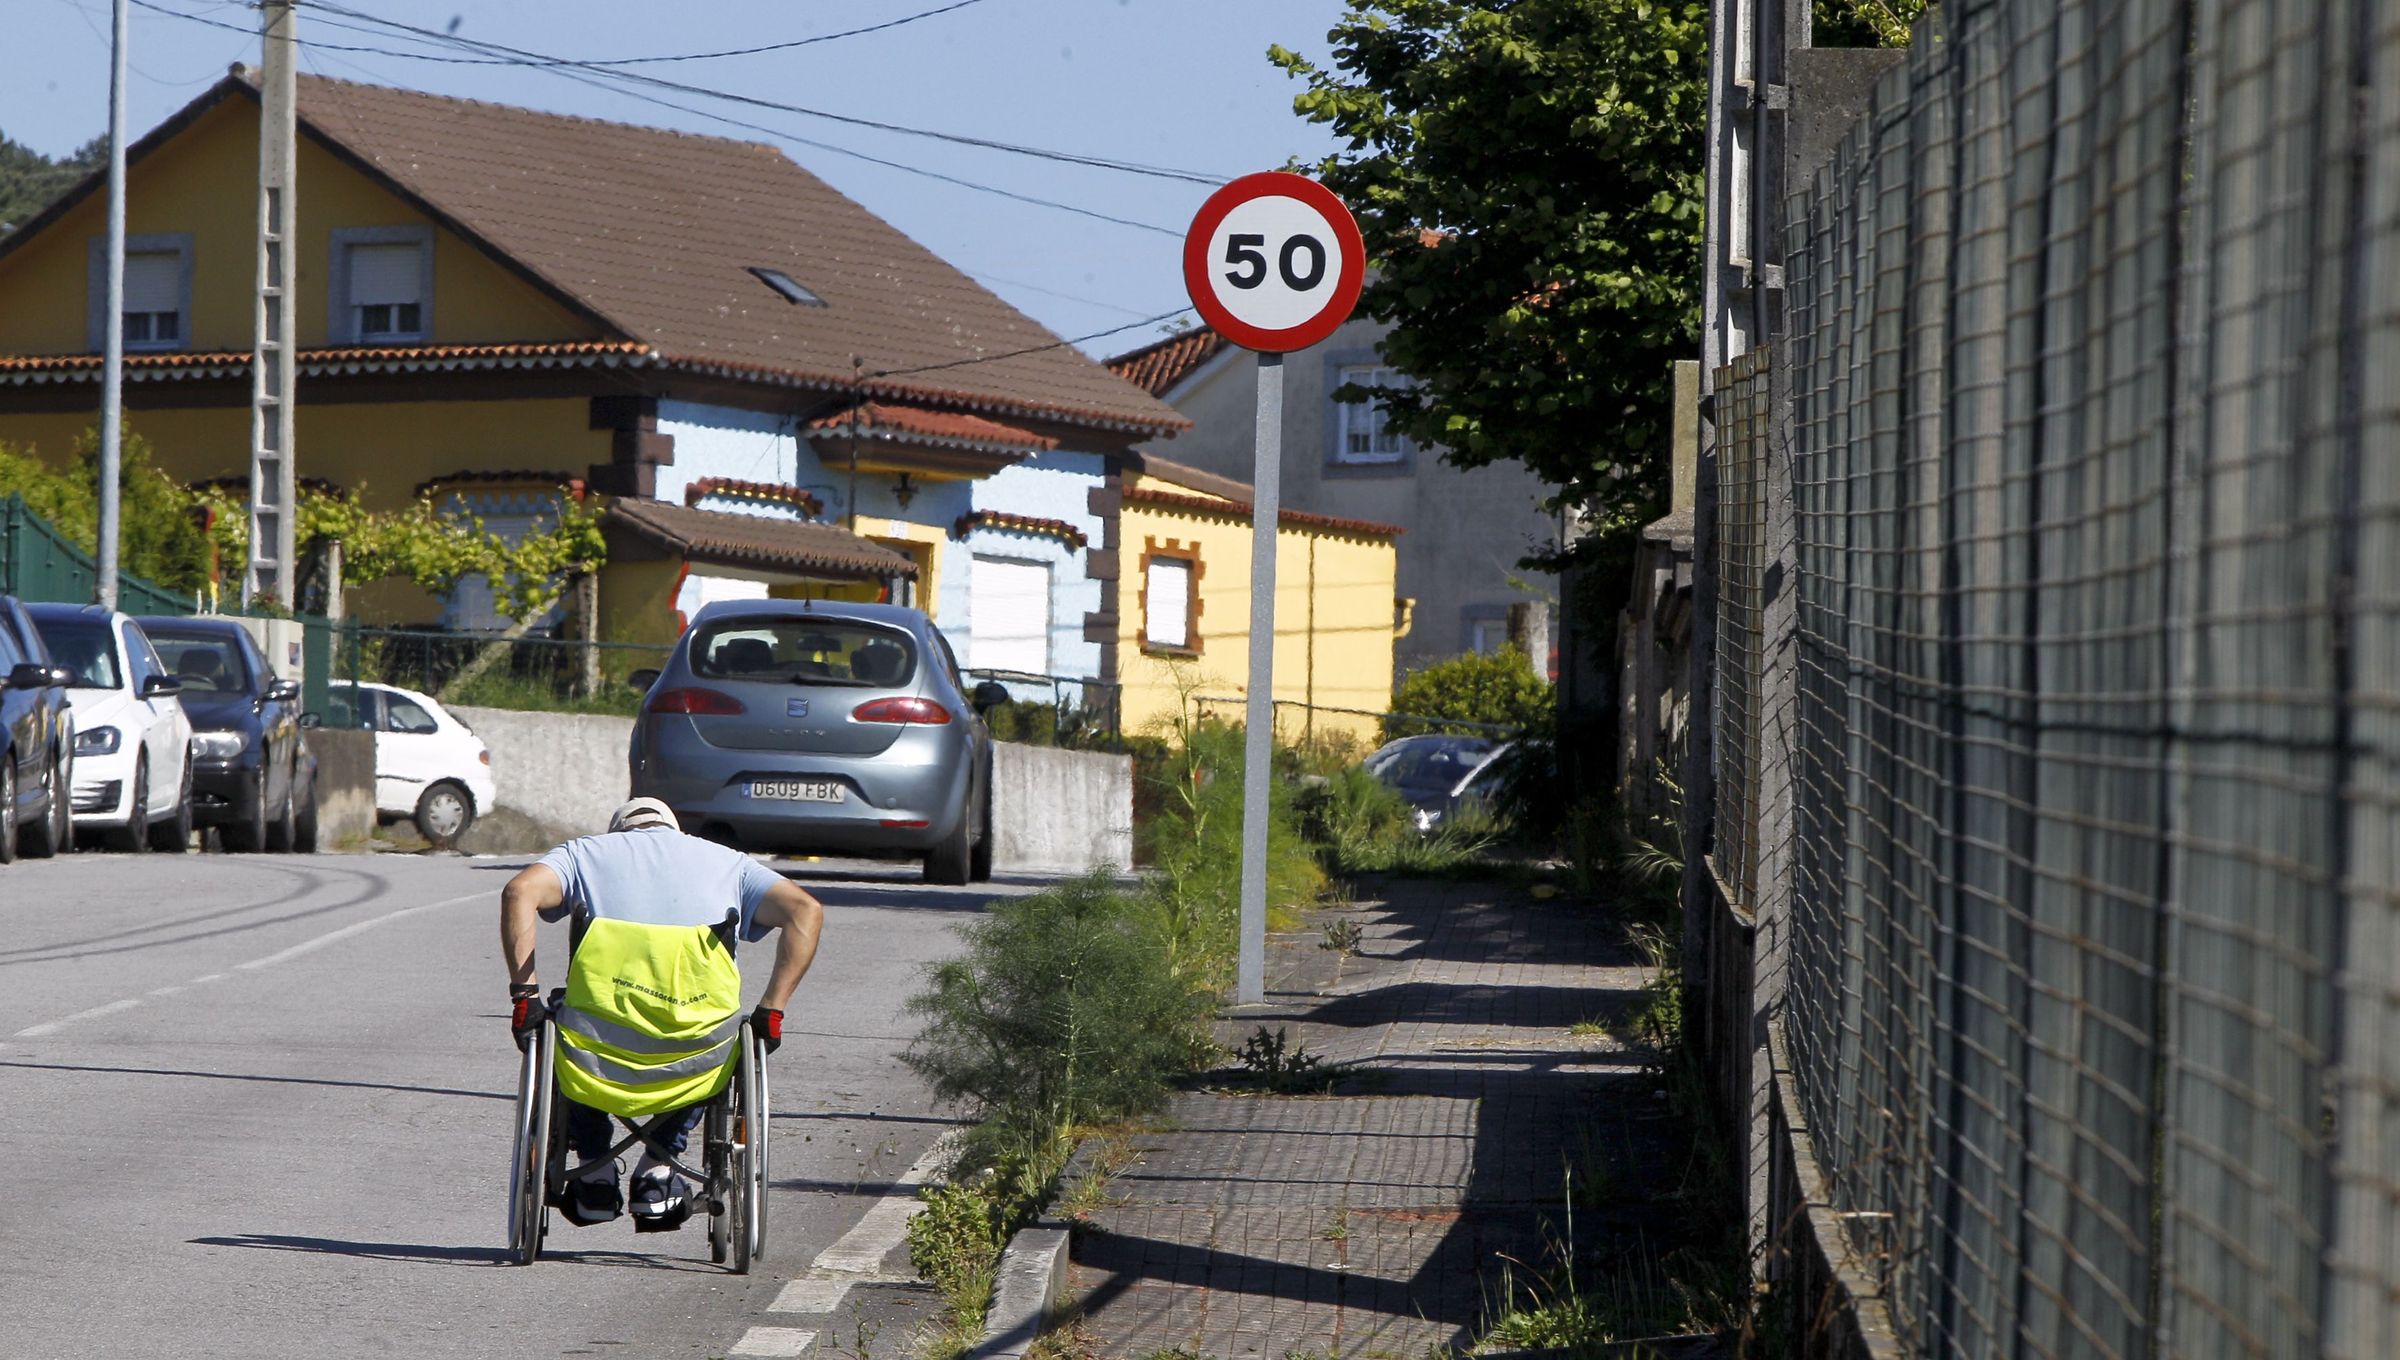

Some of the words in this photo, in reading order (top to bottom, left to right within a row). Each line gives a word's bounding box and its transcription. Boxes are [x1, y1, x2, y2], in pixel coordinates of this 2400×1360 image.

[1225, 234, 1326, 292] 50
[754, 781, 800, 798] 0609
[805, 783, 840, 800] FBK
